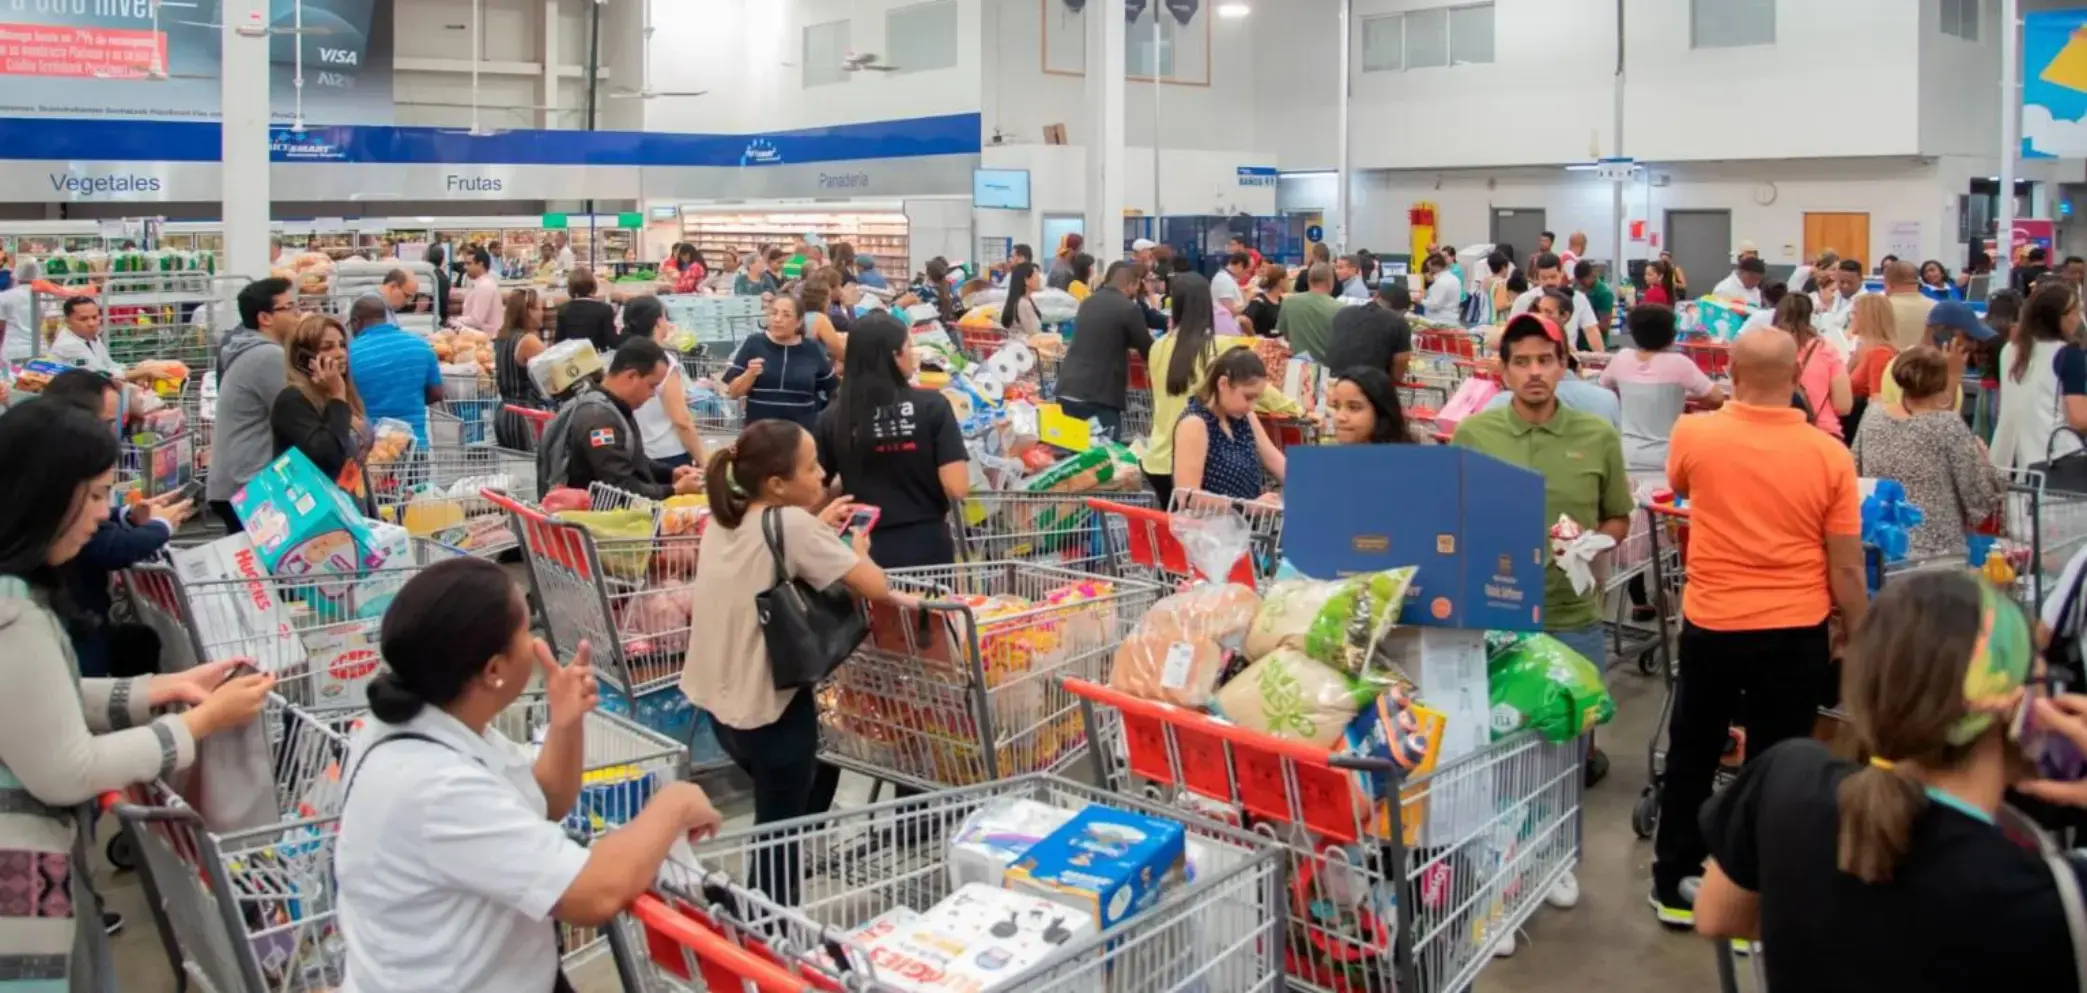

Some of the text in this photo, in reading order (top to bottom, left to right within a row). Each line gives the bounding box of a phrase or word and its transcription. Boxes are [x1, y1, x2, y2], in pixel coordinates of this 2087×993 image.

[317, 47, 358, 66] VISA
[50, 173, 161, 195] Vegetales
[447, 174, 502, 192] Frutas
